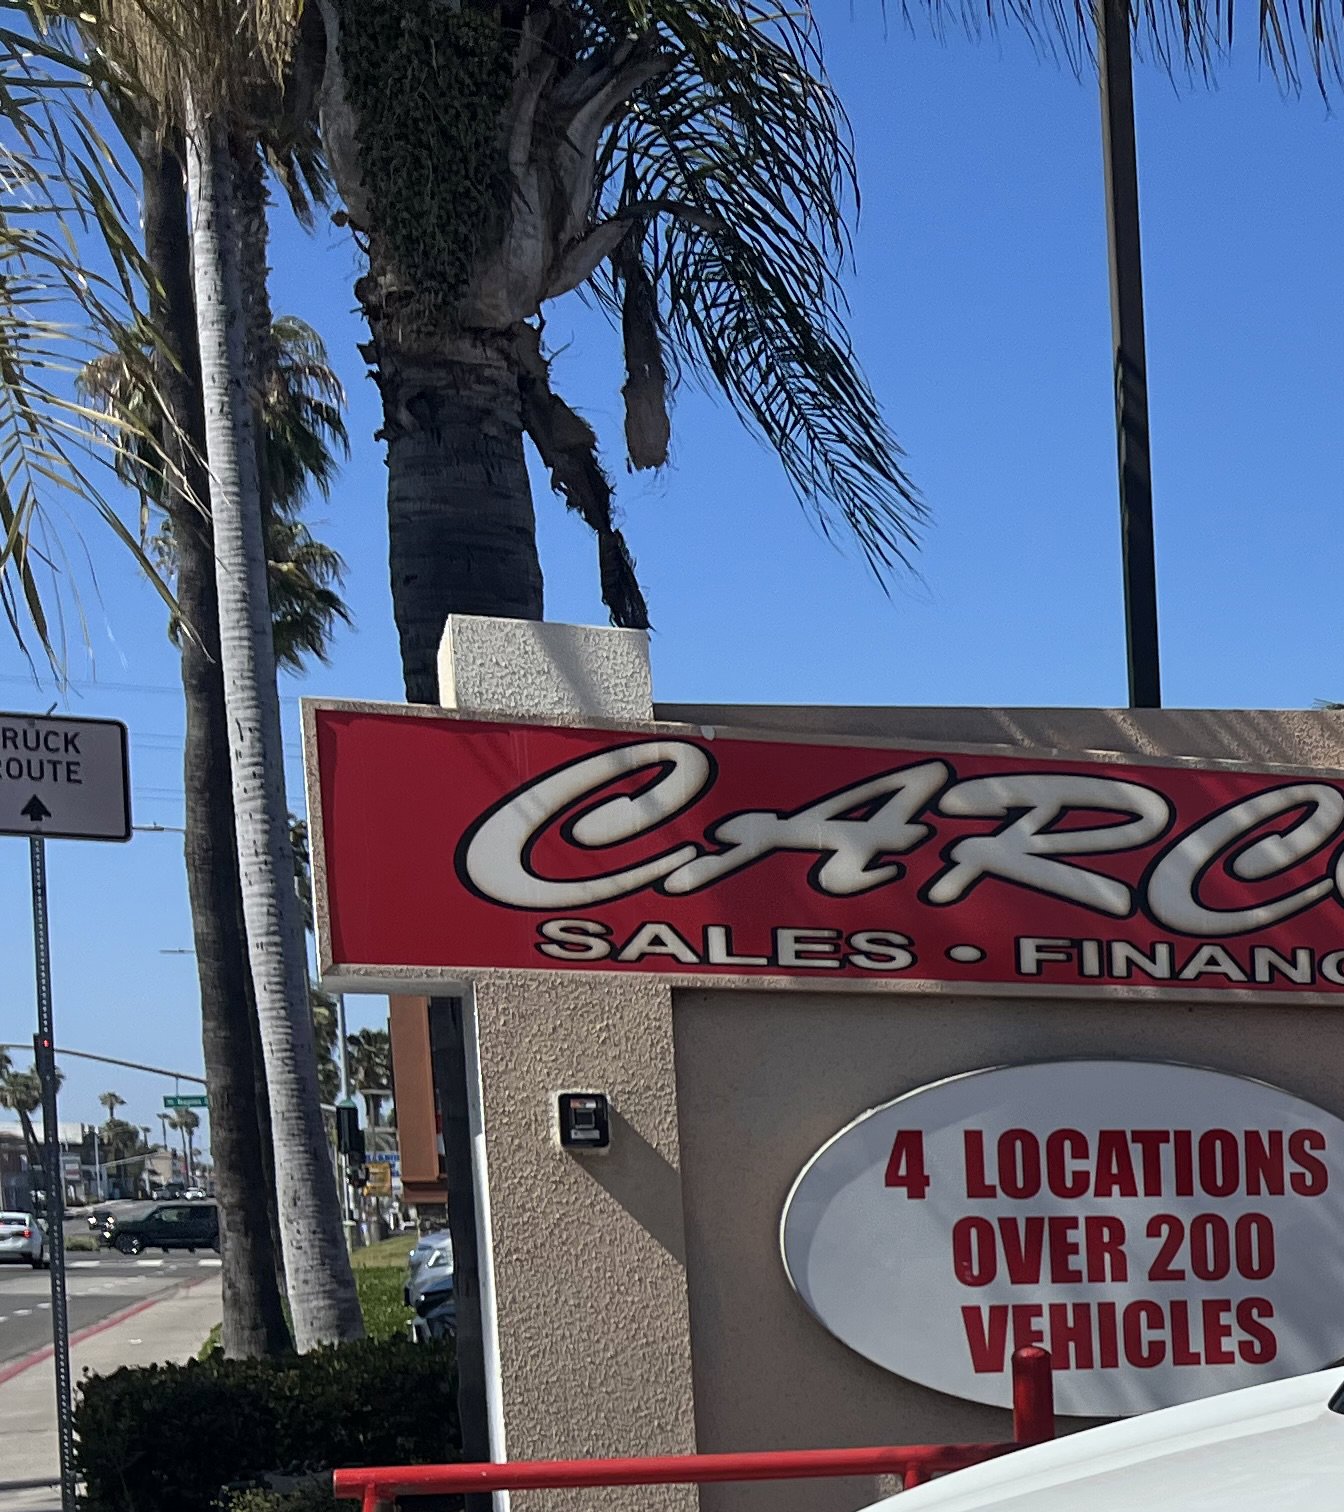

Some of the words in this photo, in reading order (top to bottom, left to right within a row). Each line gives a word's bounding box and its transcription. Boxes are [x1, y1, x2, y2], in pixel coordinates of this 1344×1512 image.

[0, 757, 82, 784] OUTE
[537, 918, 917, 971] SALES
[884, 1129, 930, 1200] 4
[963, 1127, 1329, 1199] LOCATIONS
[952, 1215, 1129, 1287] OVER
[1145, 1212, 1275, 1281] 200
[961, 1297, 1277, 1373] VEHICLES
